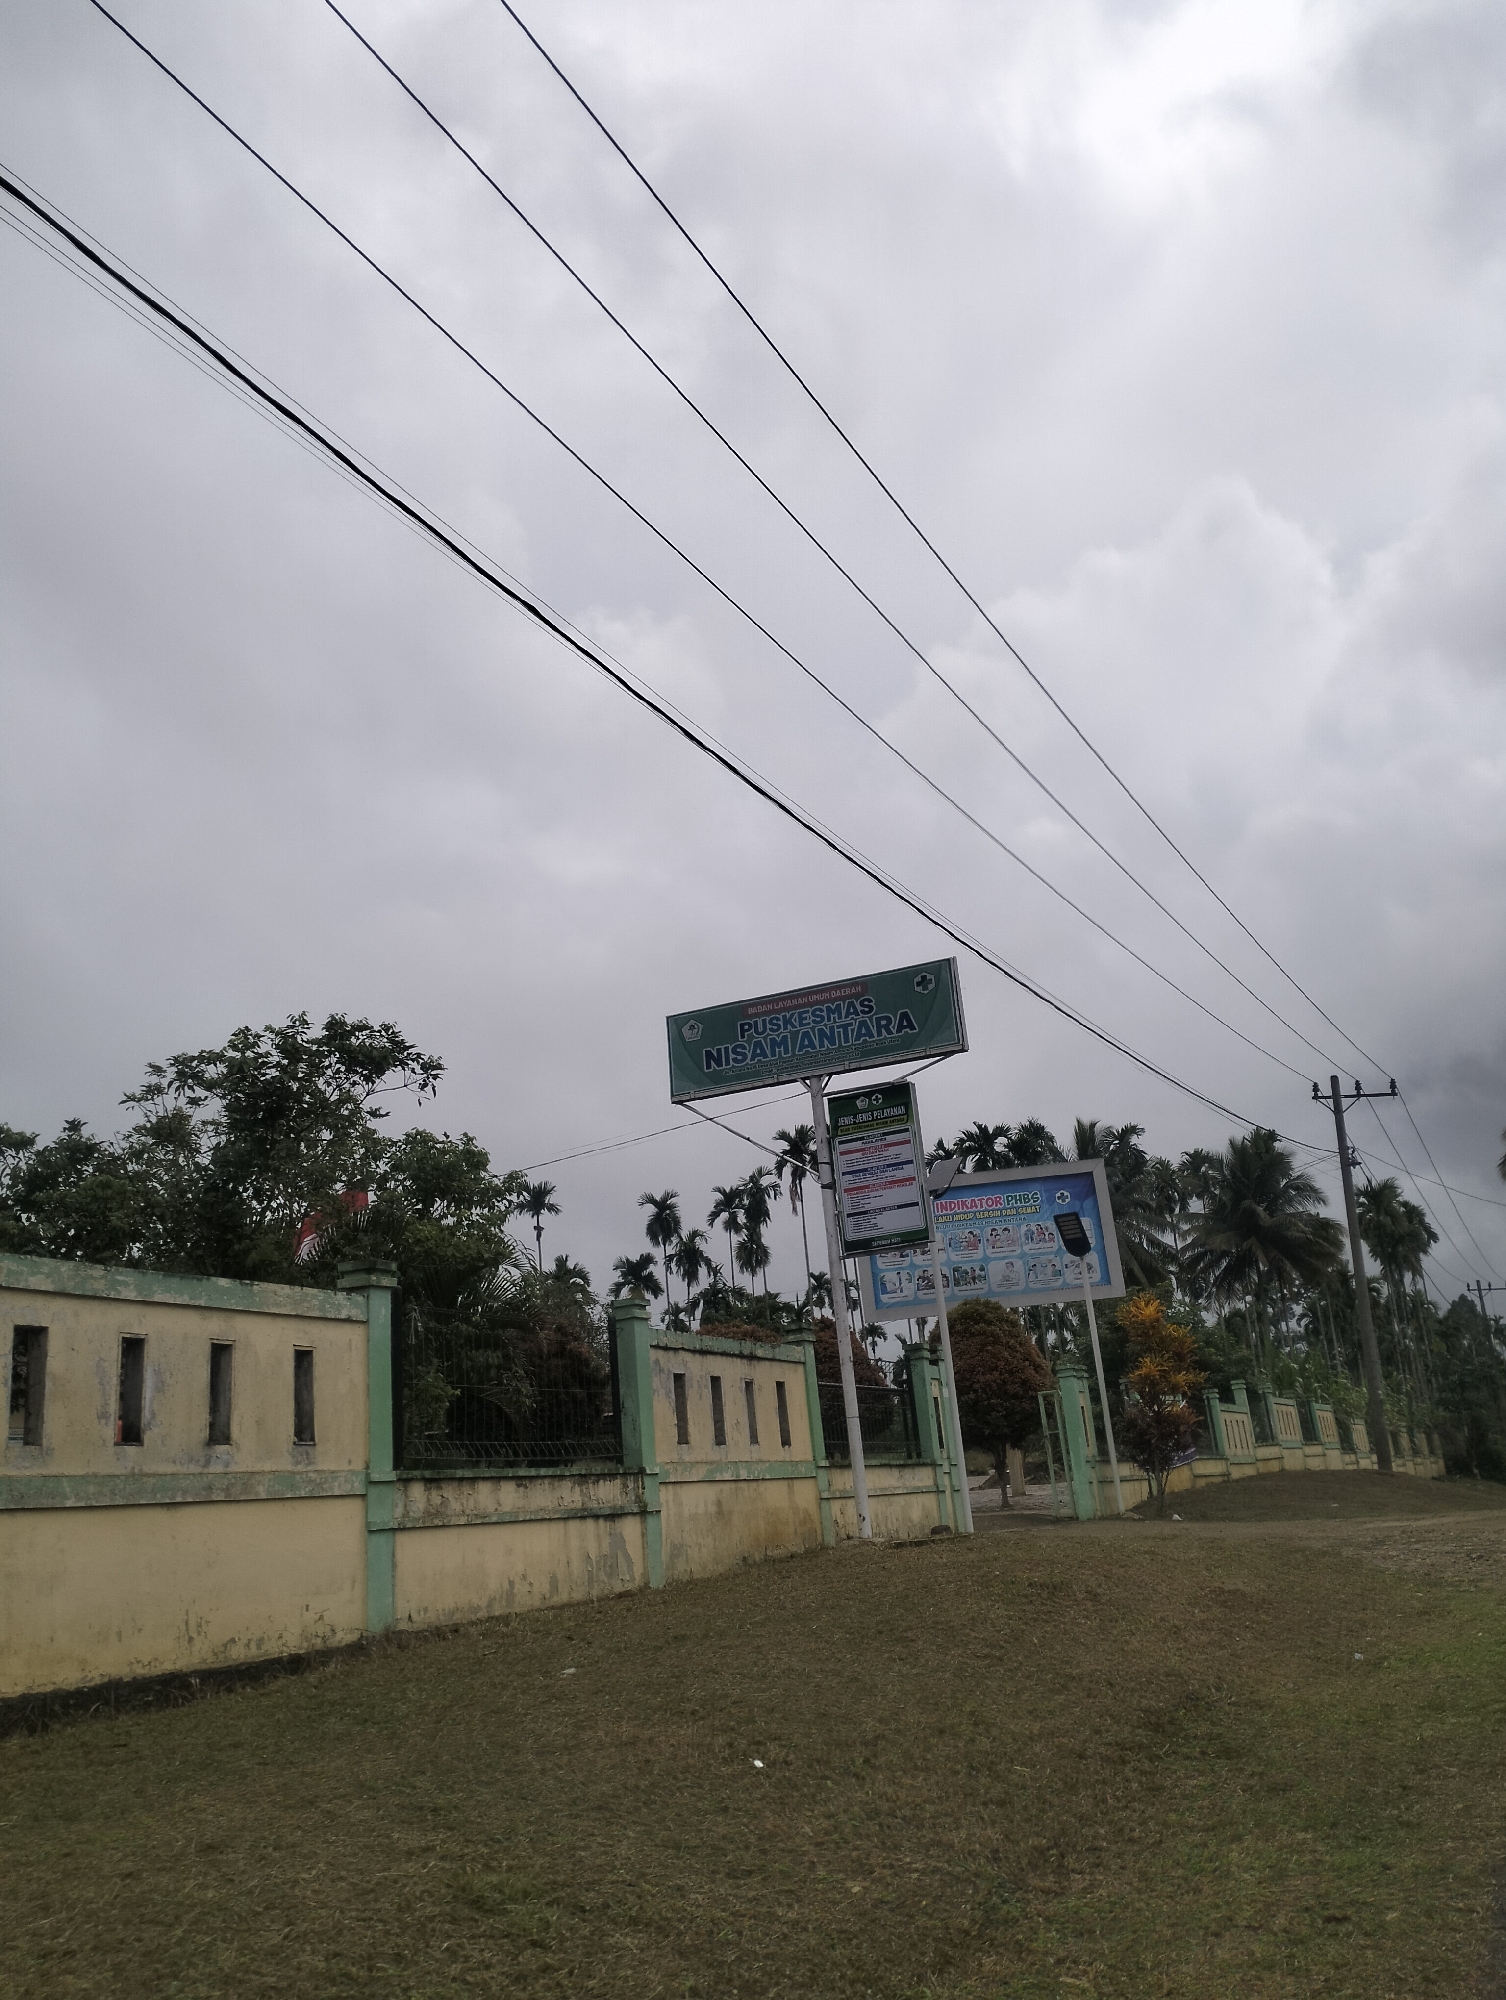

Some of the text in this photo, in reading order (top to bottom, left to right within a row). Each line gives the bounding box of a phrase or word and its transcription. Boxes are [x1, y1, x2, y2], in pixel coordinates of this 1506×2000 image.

[749, 986, 861, 1014] BADAN LAYANAN UMUM DAERAH
[738, 997, 875, 1040] PUSKESMAS
[703, 1009, 918, 1072] NISAM ANTARA
[838, 1105, 906, 1126] JENIS-JENIS PELAYANAN
[935, 1191, 1041, 1214] INDIKATOR PHBS
[975, 1209, 1001, 1219] BERSIH
